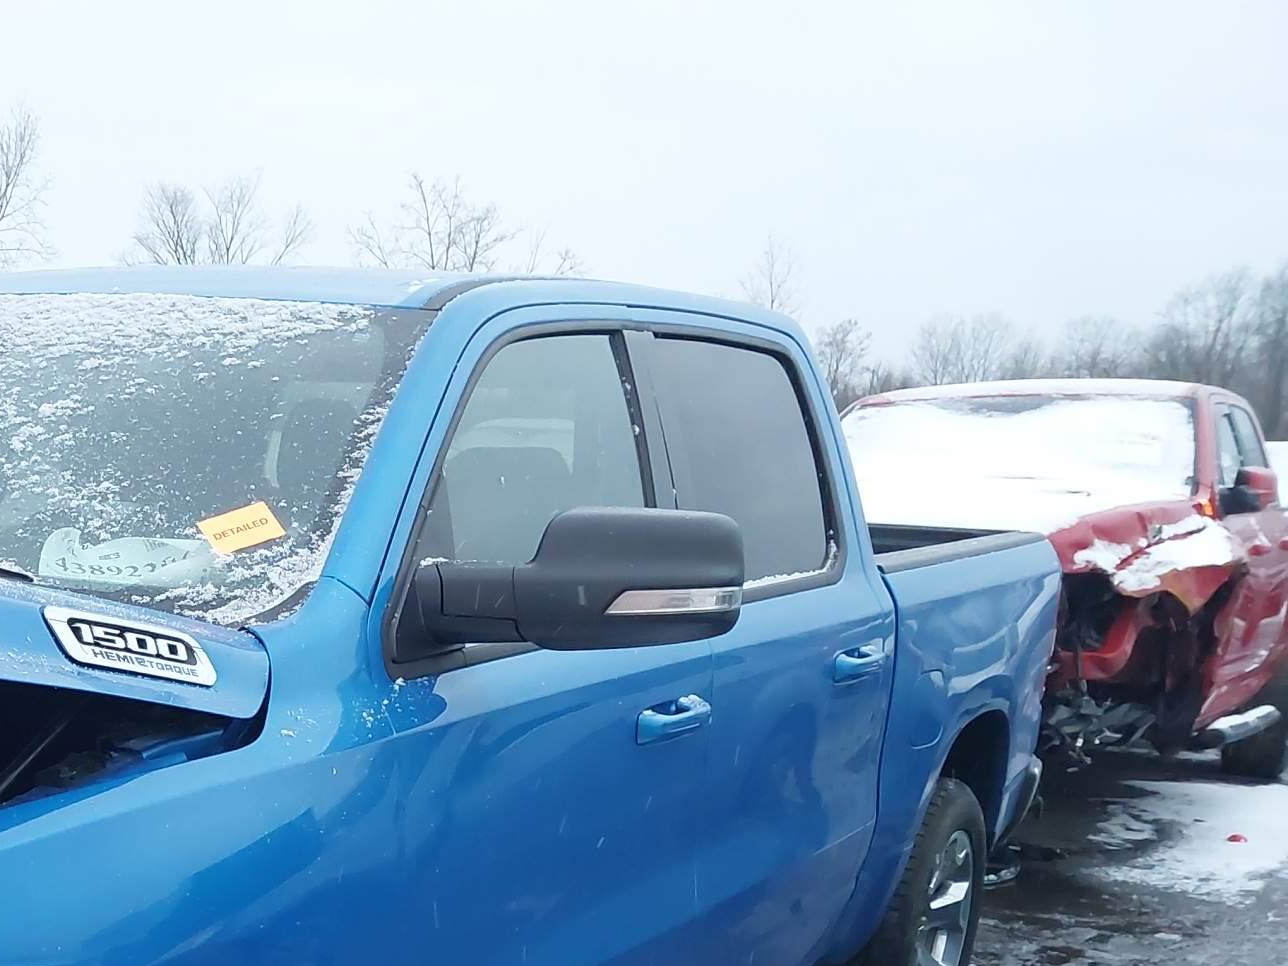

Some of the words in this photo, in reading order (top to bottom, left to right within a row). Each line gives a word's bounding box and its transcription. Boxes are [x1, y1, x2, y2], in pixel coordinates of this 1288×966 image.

[213, 517, 269, 541] DETAILED
[71, 622, 189, 662] 1500
[92, 648, 135, 665] HEMI
